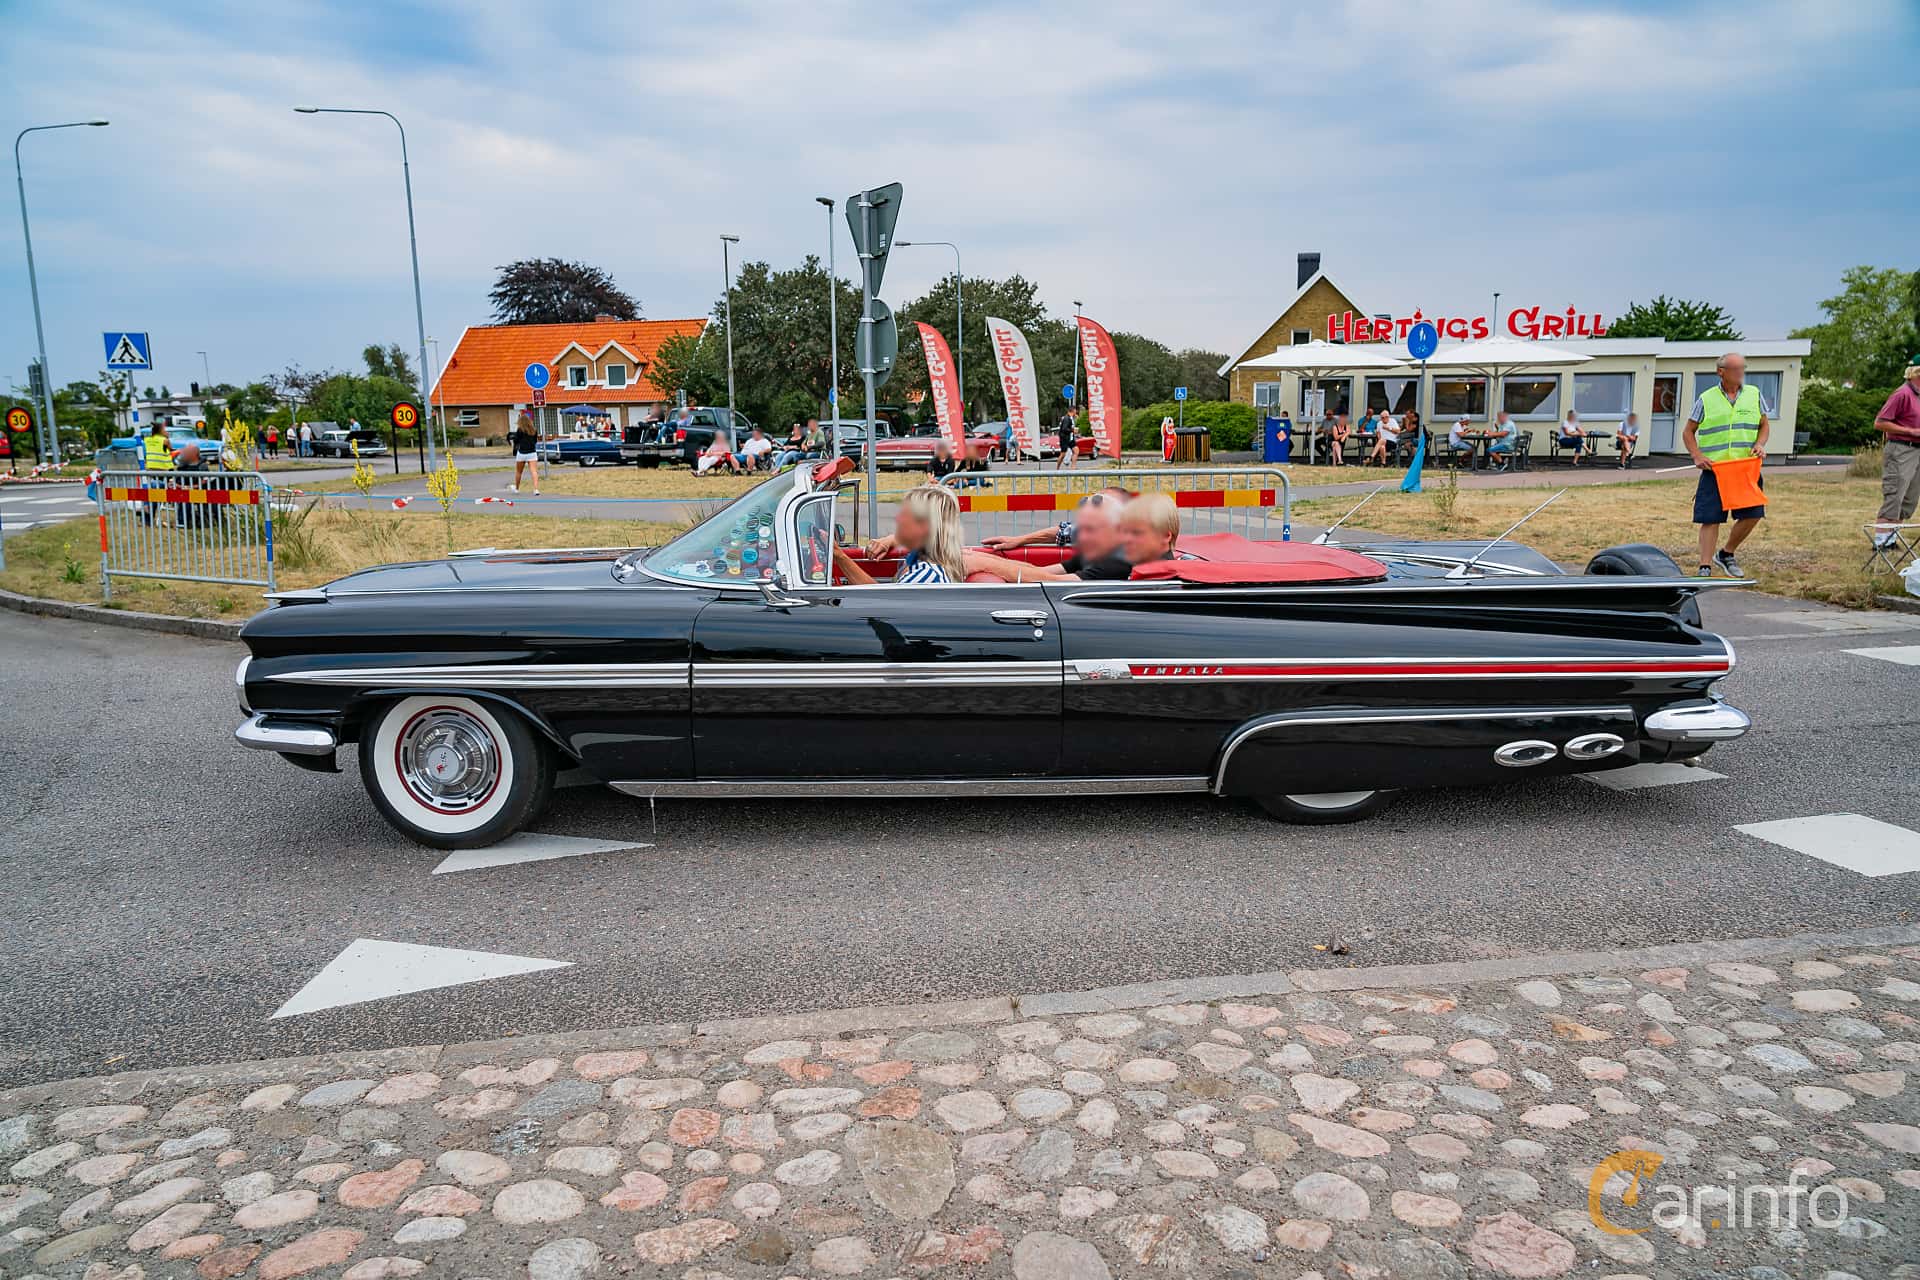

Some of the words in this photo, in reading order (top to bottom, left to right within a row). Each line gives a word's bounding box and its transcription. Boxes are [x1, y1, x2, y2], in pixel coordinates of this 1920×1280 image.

[11, 414, 27, 426] 30
[397, 410, 413, 422] 30
[1143, 666, 1224, 675] IMPALA
